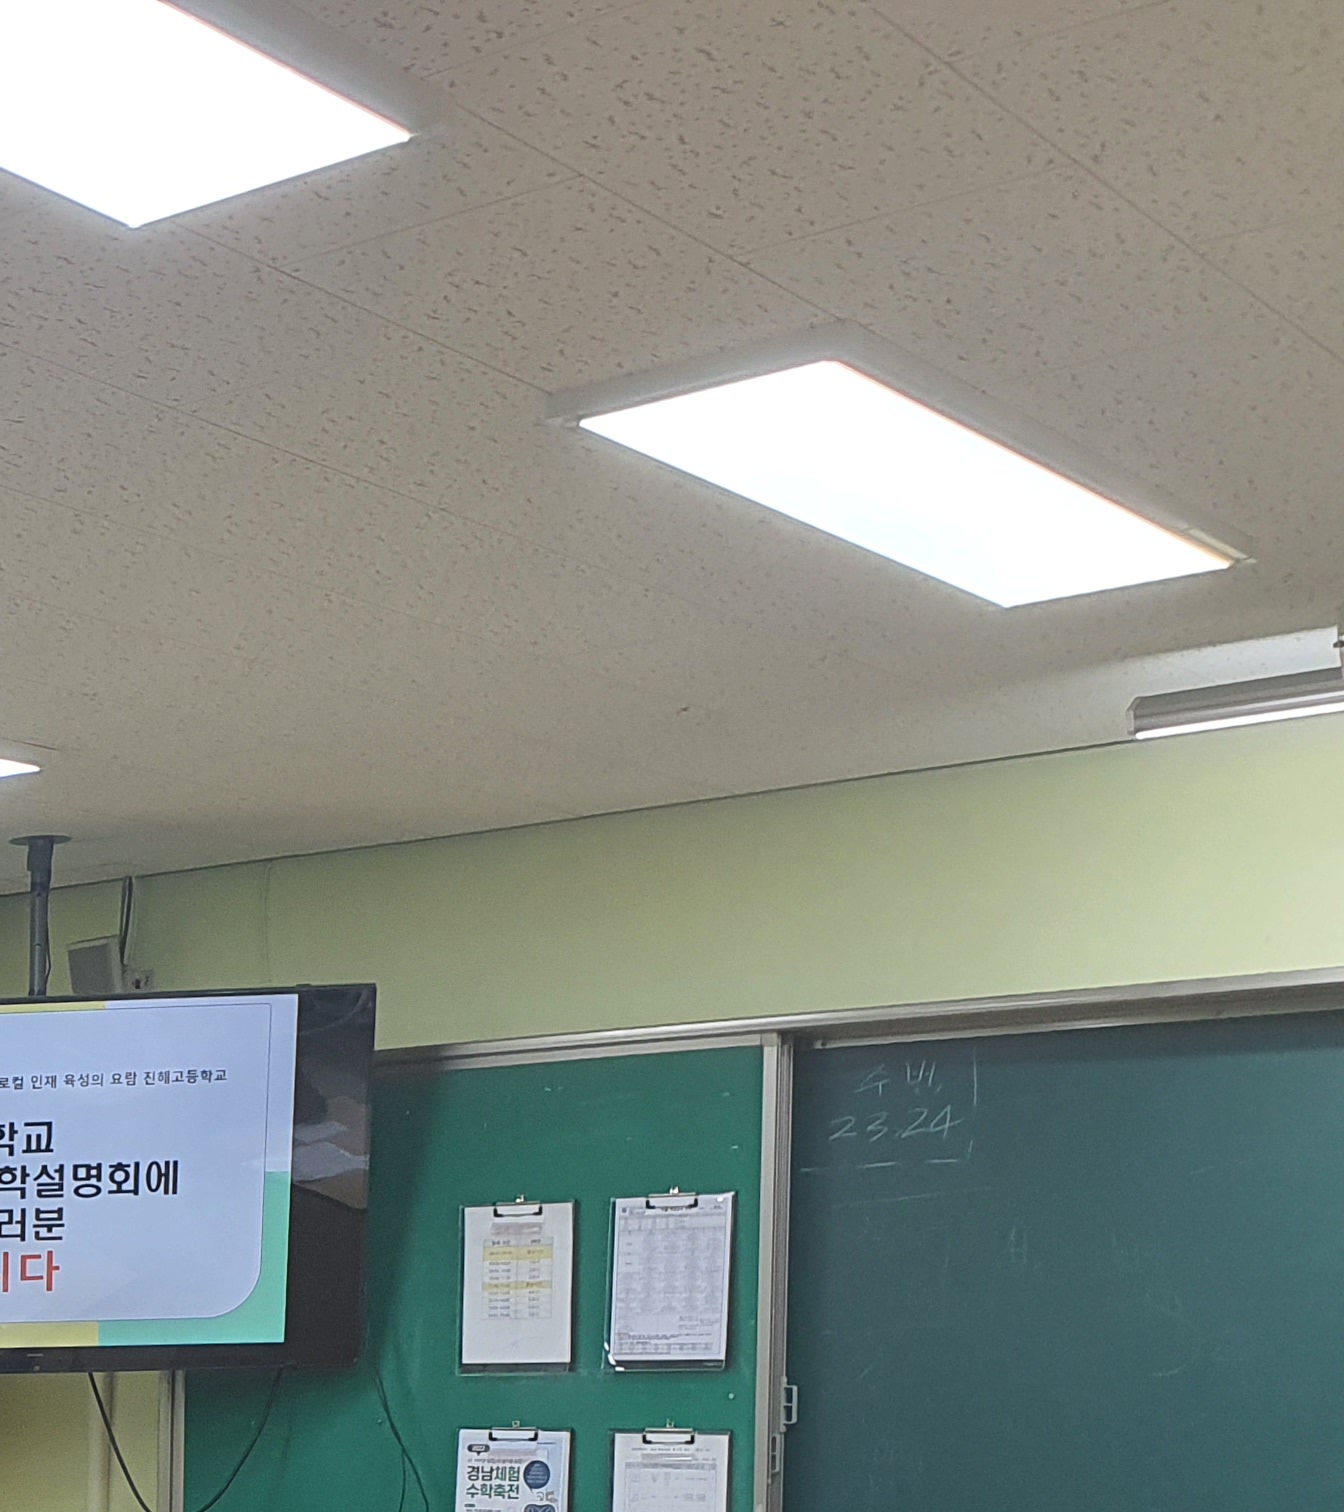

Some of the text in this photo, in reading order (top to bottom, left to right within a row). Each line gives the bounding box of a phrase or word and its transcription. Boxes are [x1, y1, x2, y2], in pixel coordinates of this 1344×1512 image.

[30, 1074, 57, 1089] 인재
[64, 1073, 105, 1088] 육성의
[110, 1071, 137, 1086] 요람
[143, 1069, 228, 1085] 진해고등학교
[466, 1483, 520, 1500] 수학축전
